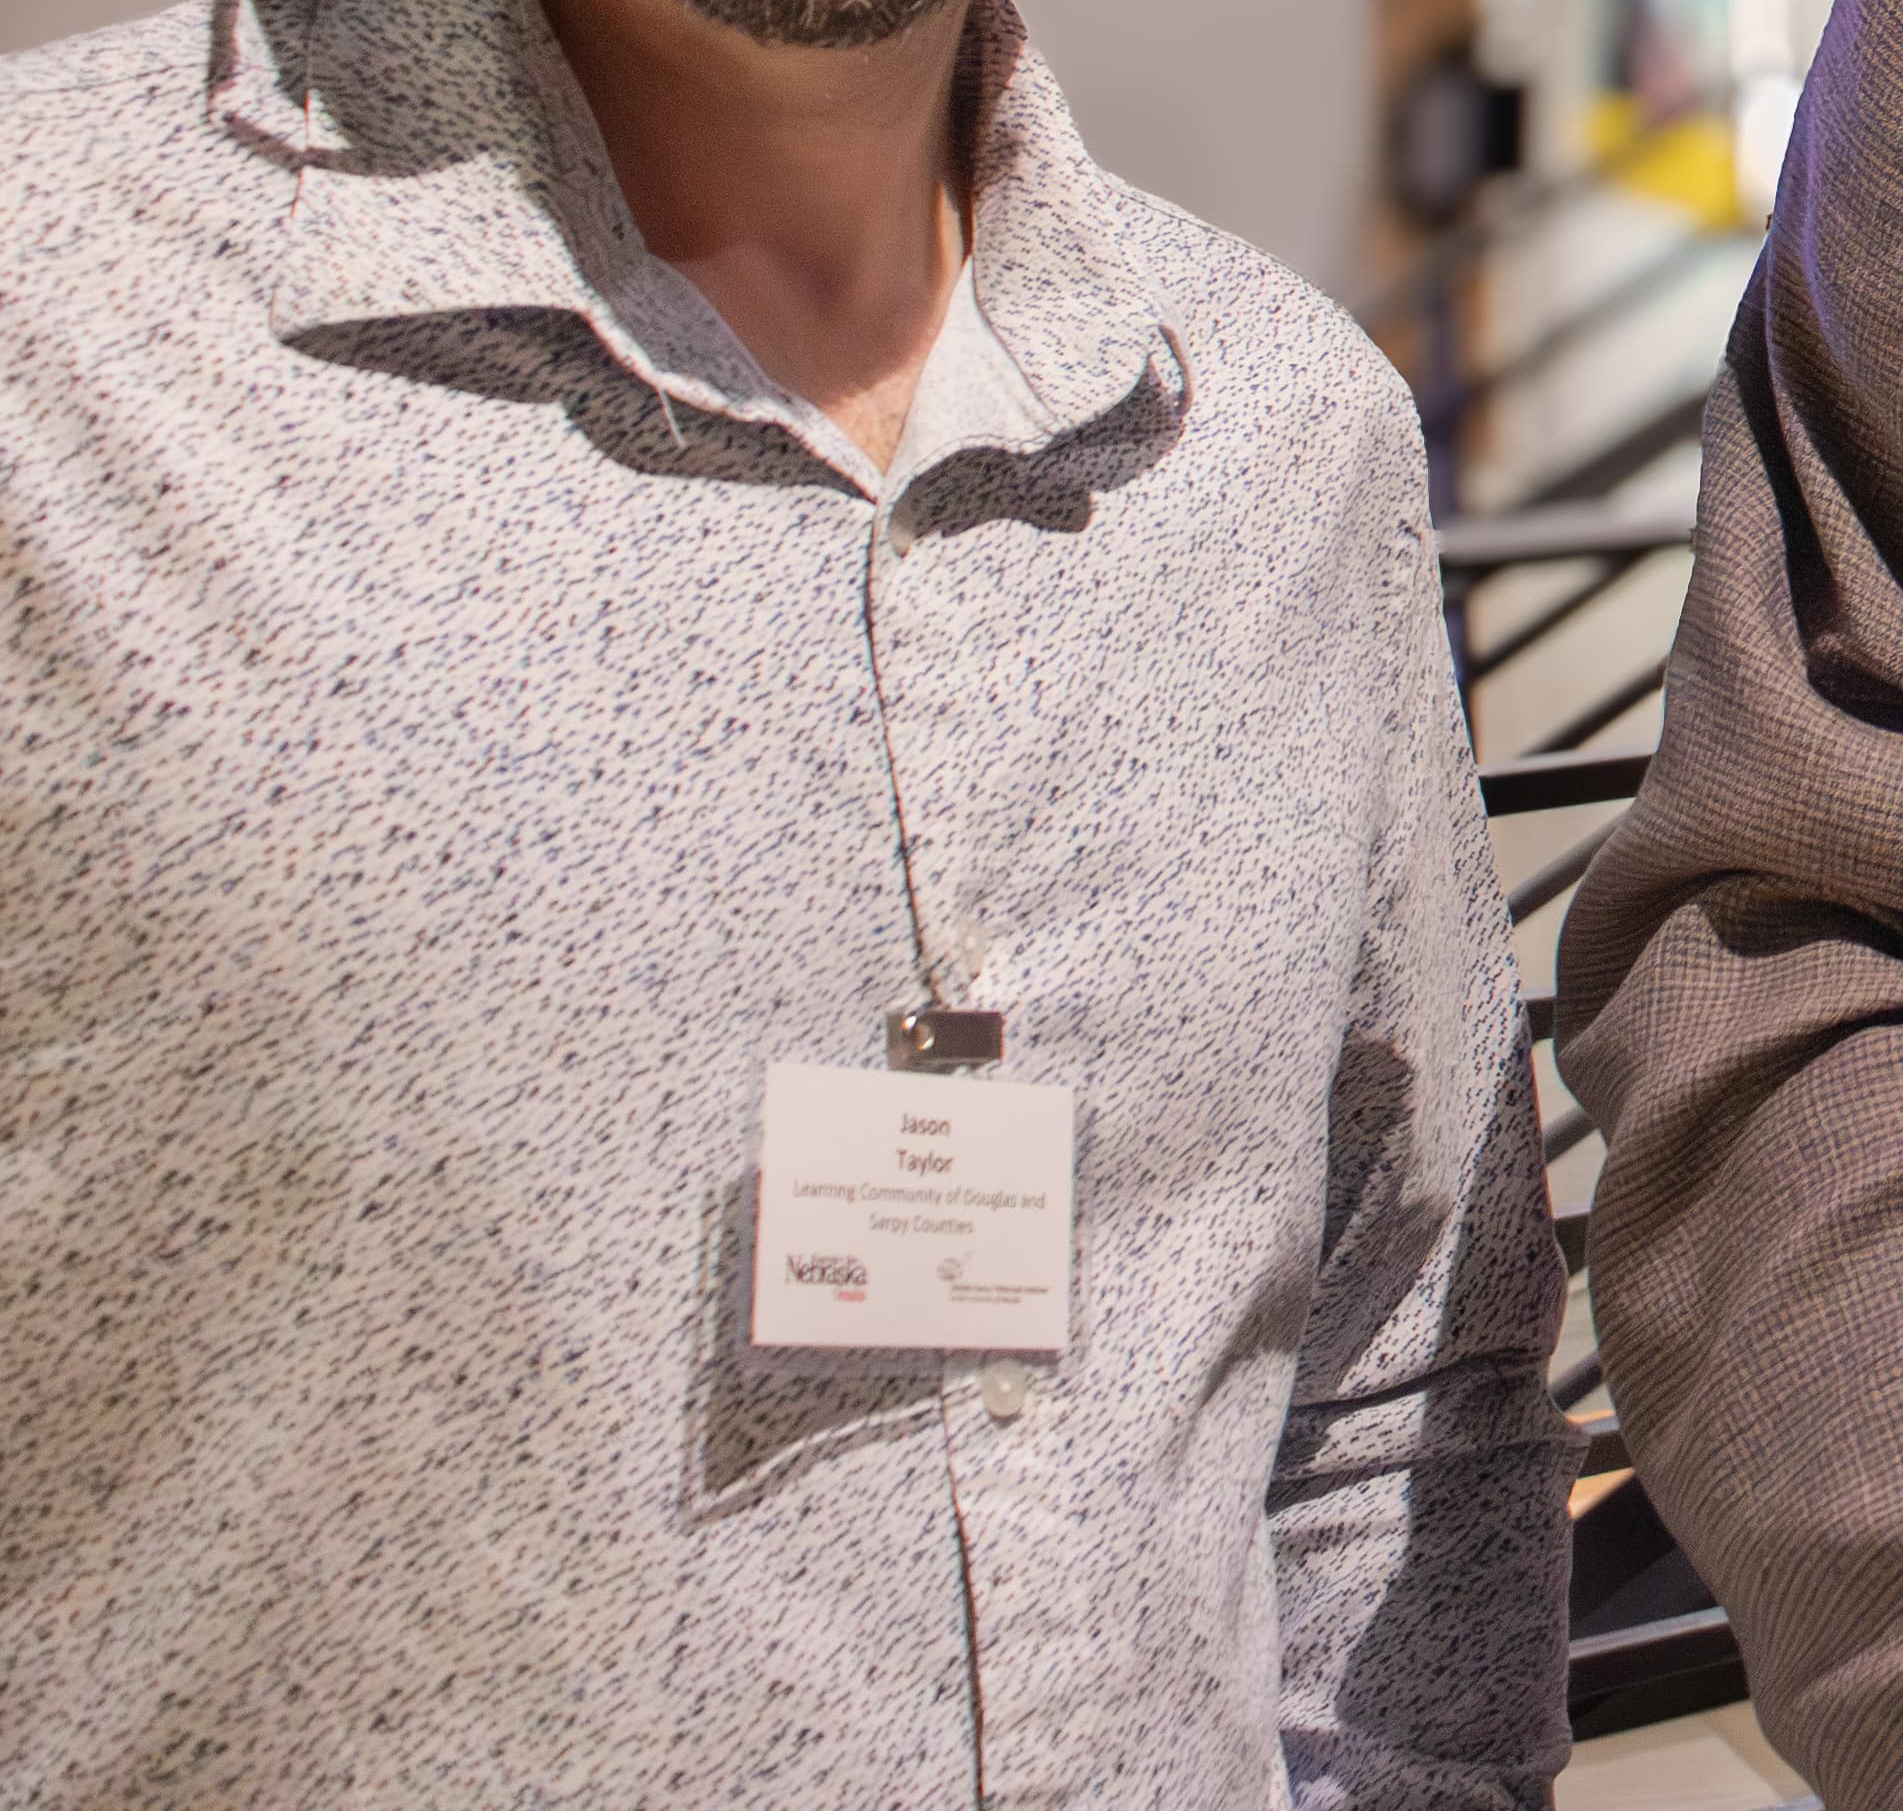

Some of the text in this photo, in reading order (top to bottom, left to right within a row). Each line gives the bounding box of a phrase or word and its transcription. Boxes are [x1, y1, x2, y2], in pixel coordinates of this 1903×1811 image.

[900, 1113, 951, 1137] Jason
[896, 1149, 955, 1176] Taylor
[793, 1180, 1047, 1211] Learning Community of Douglas and
[869, 1212, 975, 1236] Sarpy Counties
